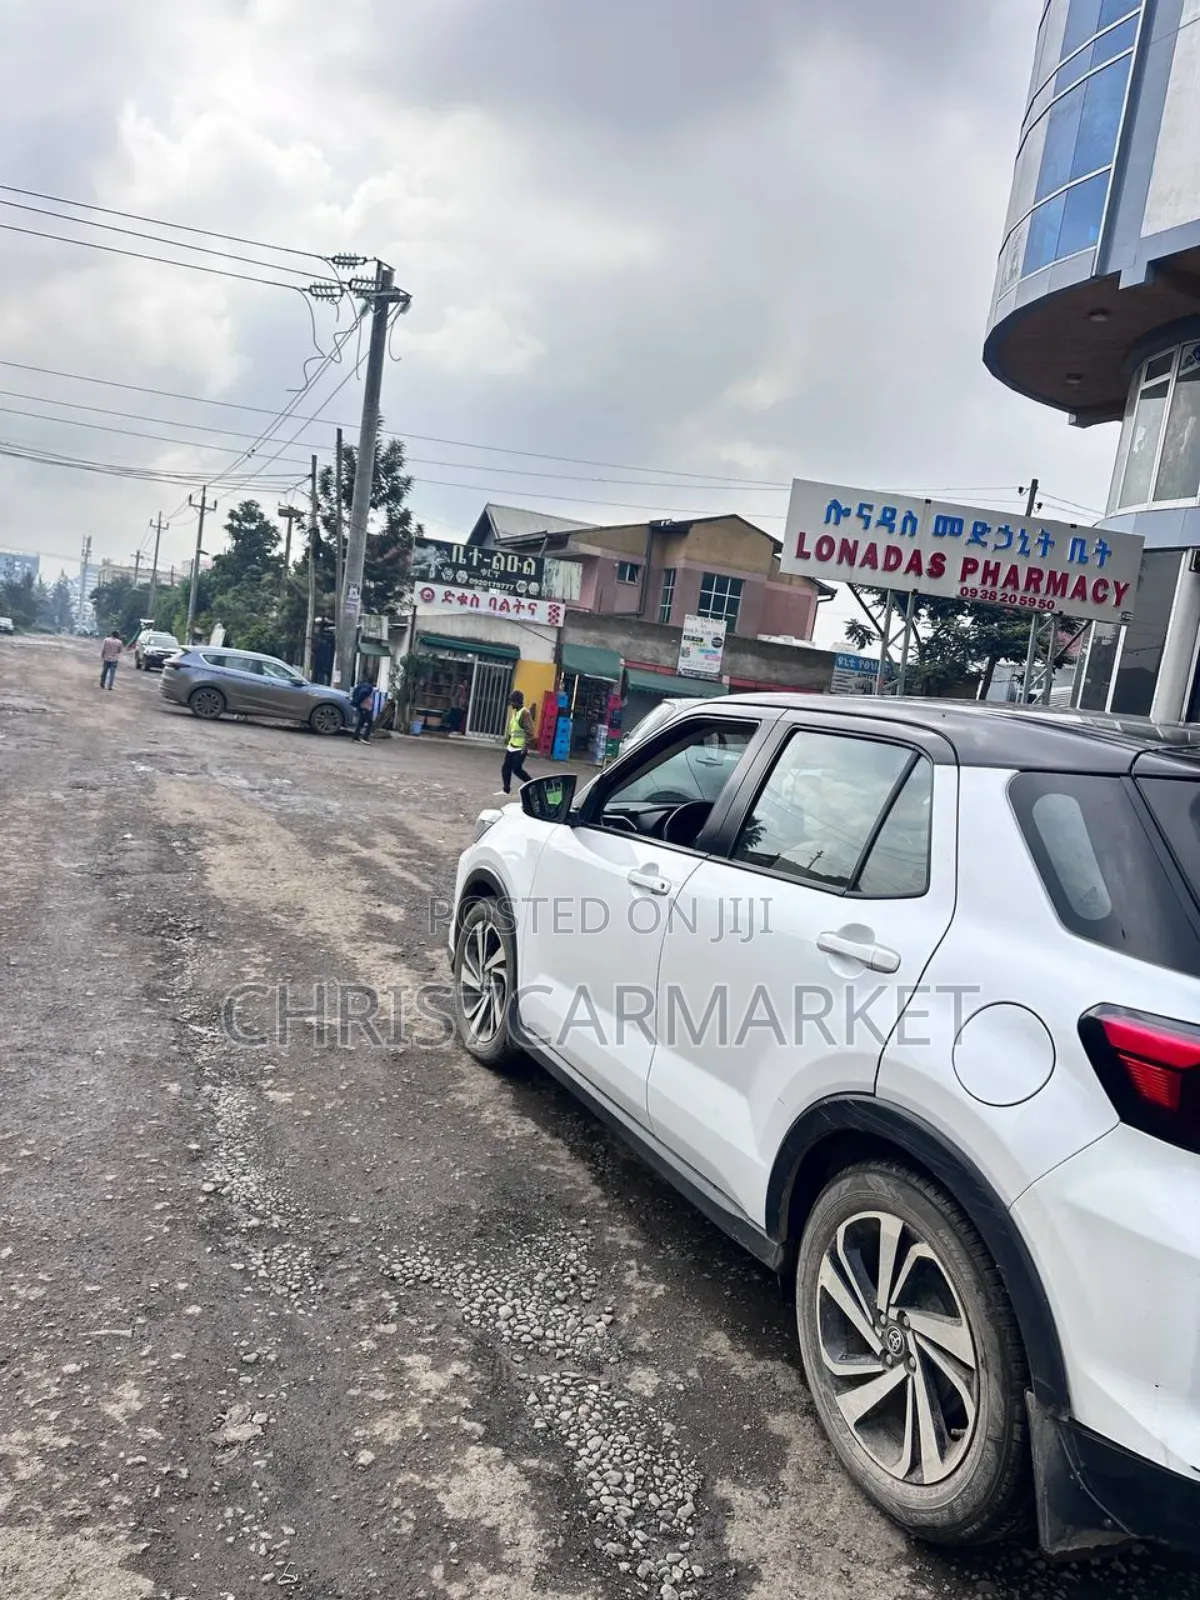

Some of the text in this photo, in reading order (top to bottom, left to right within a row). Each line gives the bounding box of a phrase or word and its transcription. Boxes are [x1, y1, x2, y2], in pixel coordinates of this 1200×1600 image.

[932, 513, 1056, 559] መድኃኒት
[1067, 537, 1113, 569] ቤት
[795, 531, 1131, 608] LONADAS PHARMACY
[488, 597, 538, 617] ባልትና
